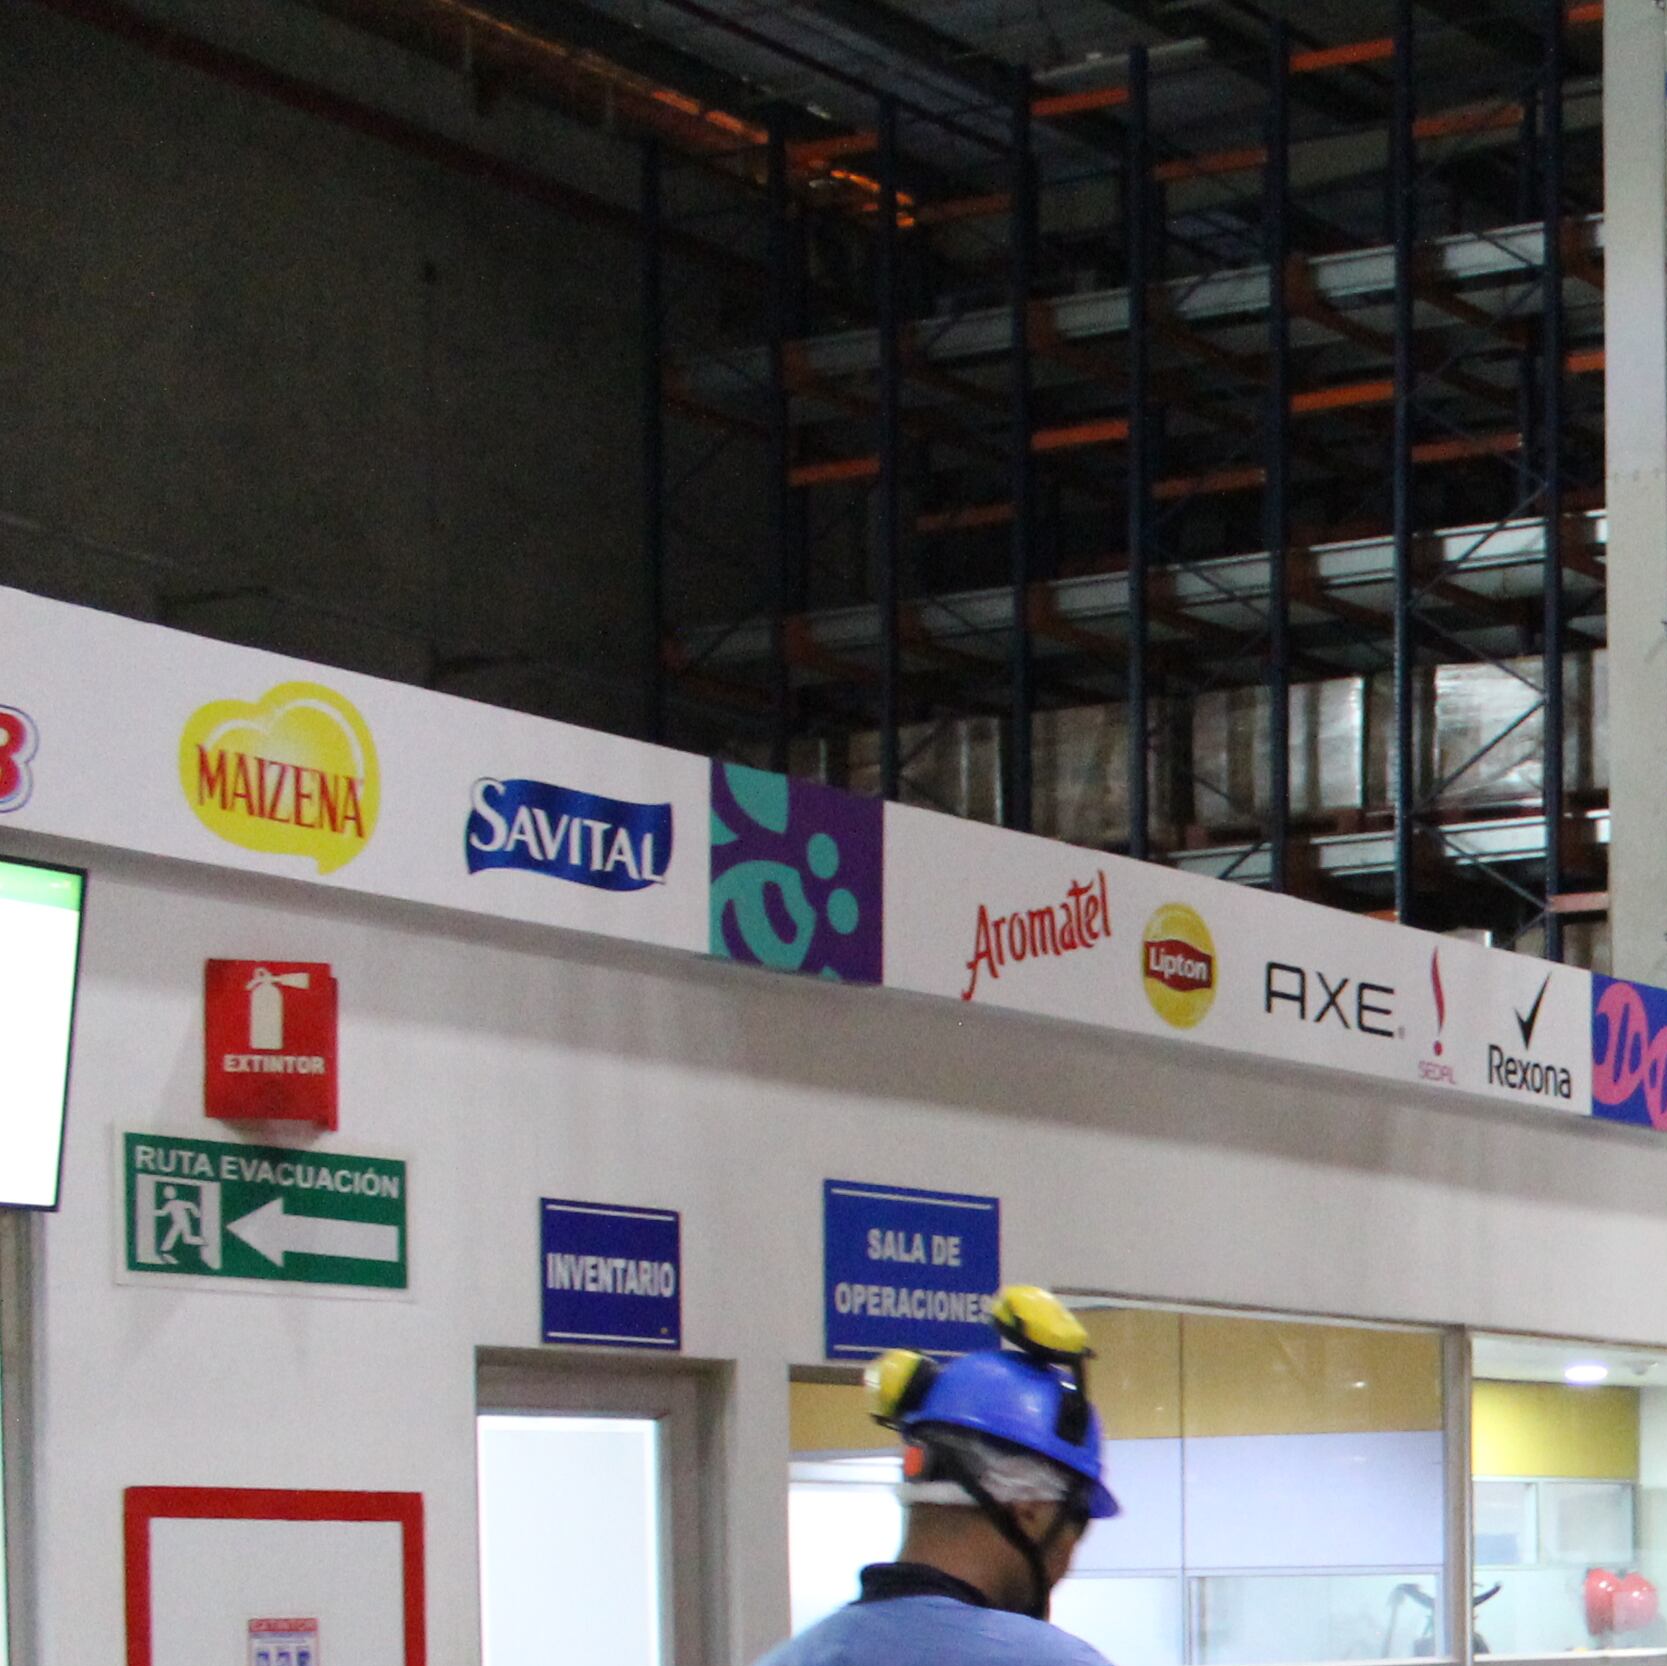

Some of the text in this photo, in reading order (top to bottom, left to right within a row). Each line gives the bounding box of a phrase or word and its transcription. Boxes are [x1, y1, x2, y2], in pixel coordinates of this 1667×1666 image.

[195, 743, 367, 840] MAIZENA
[470, 776, 665, 886] SAVITAL
[961, 870, 1111, 1001] Aromatel
[1149, 945, 1209, 983] Lipton
[1265, 961, 1395, 1039] AXE
[223, 1053, 326, 1076] EXTINTOR
[1488, 1044, 1572, 1099] Rexona
[135, 1145, 400, 1199] RUTA EVACUACIÓN
[867, 1228, 962, 1267] SALA DE
[547, 1253, 675, 1298] INVENTARIO
[835, 1282, 993, 1324] OPERACIONES
